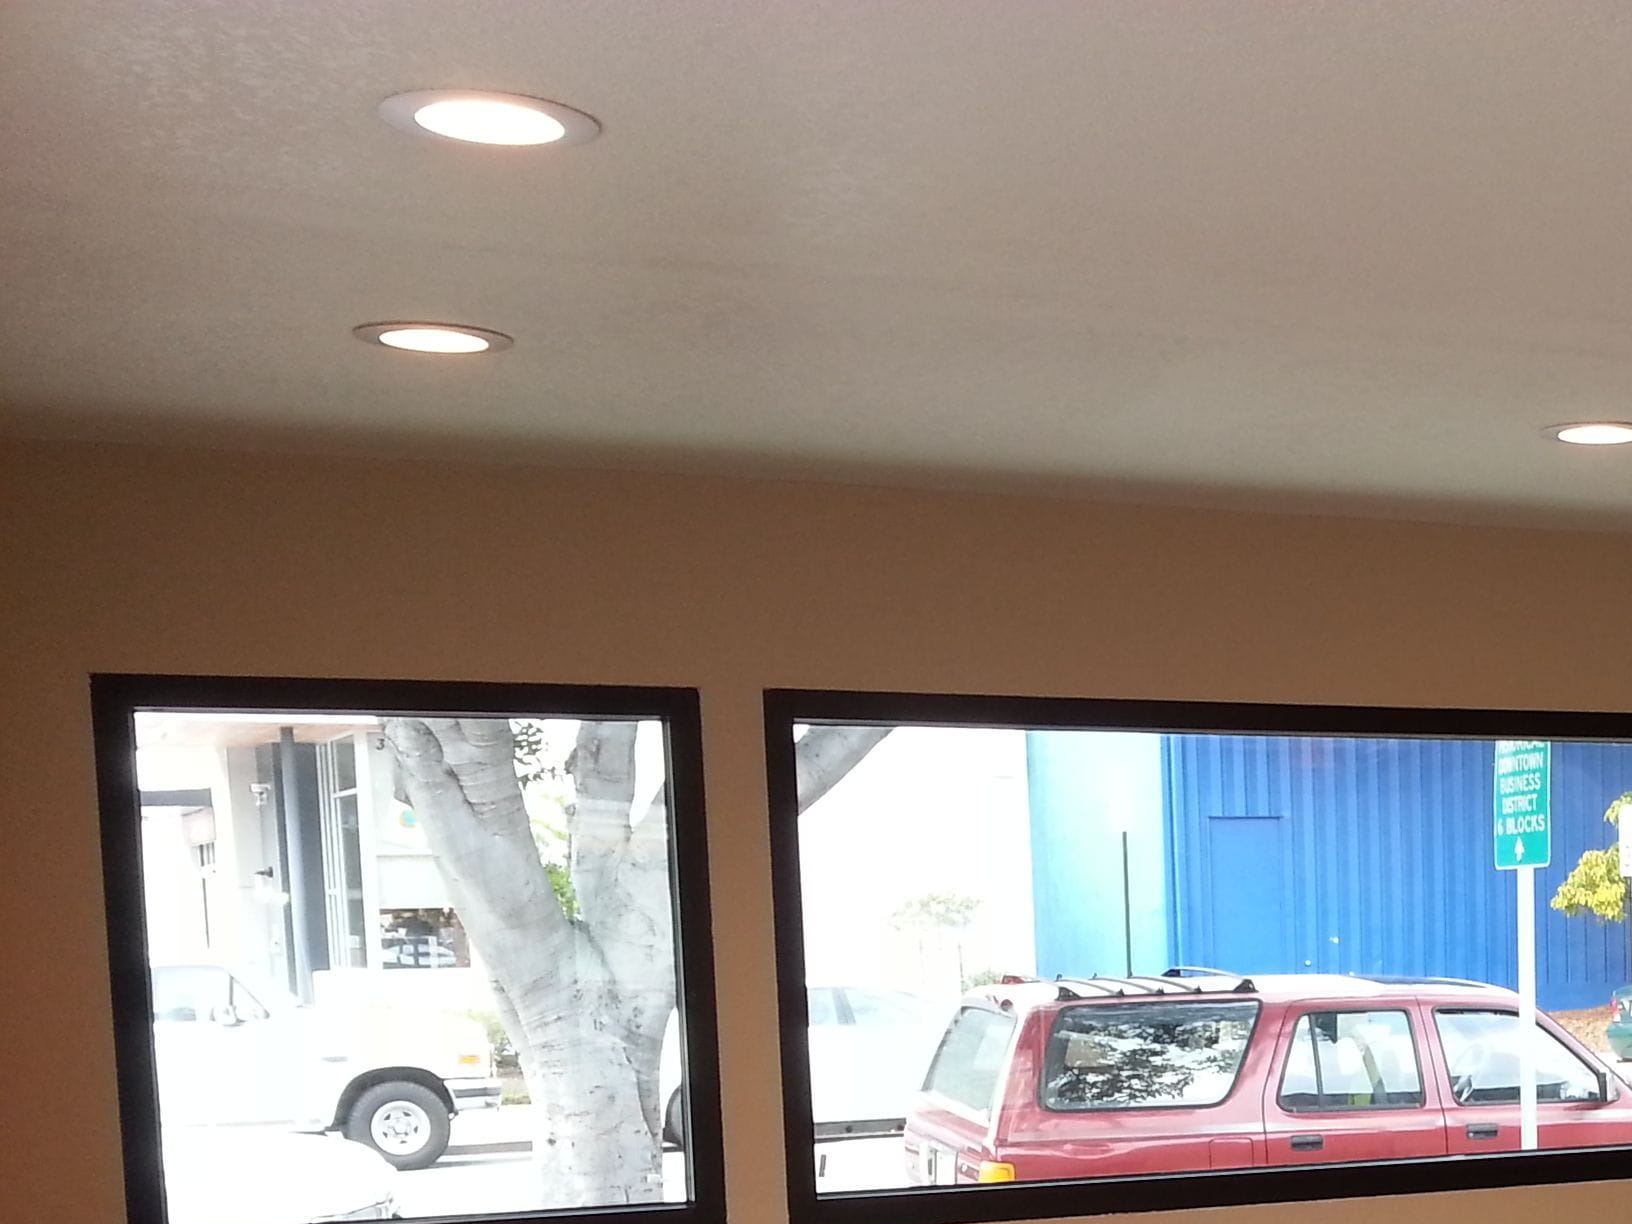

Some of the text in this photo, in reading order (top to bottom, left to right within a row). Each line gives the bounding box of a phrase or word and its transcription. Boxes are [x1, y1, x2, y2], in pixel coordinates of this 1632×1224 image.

[1498, 752, 1544, 775] DOWNTOWN
[1500, 773, 1541, 796] BUSINESS
[1502, 794, 1538, 815] DISTRICT
[1506, 815, 1546, 836] BLOCKS
